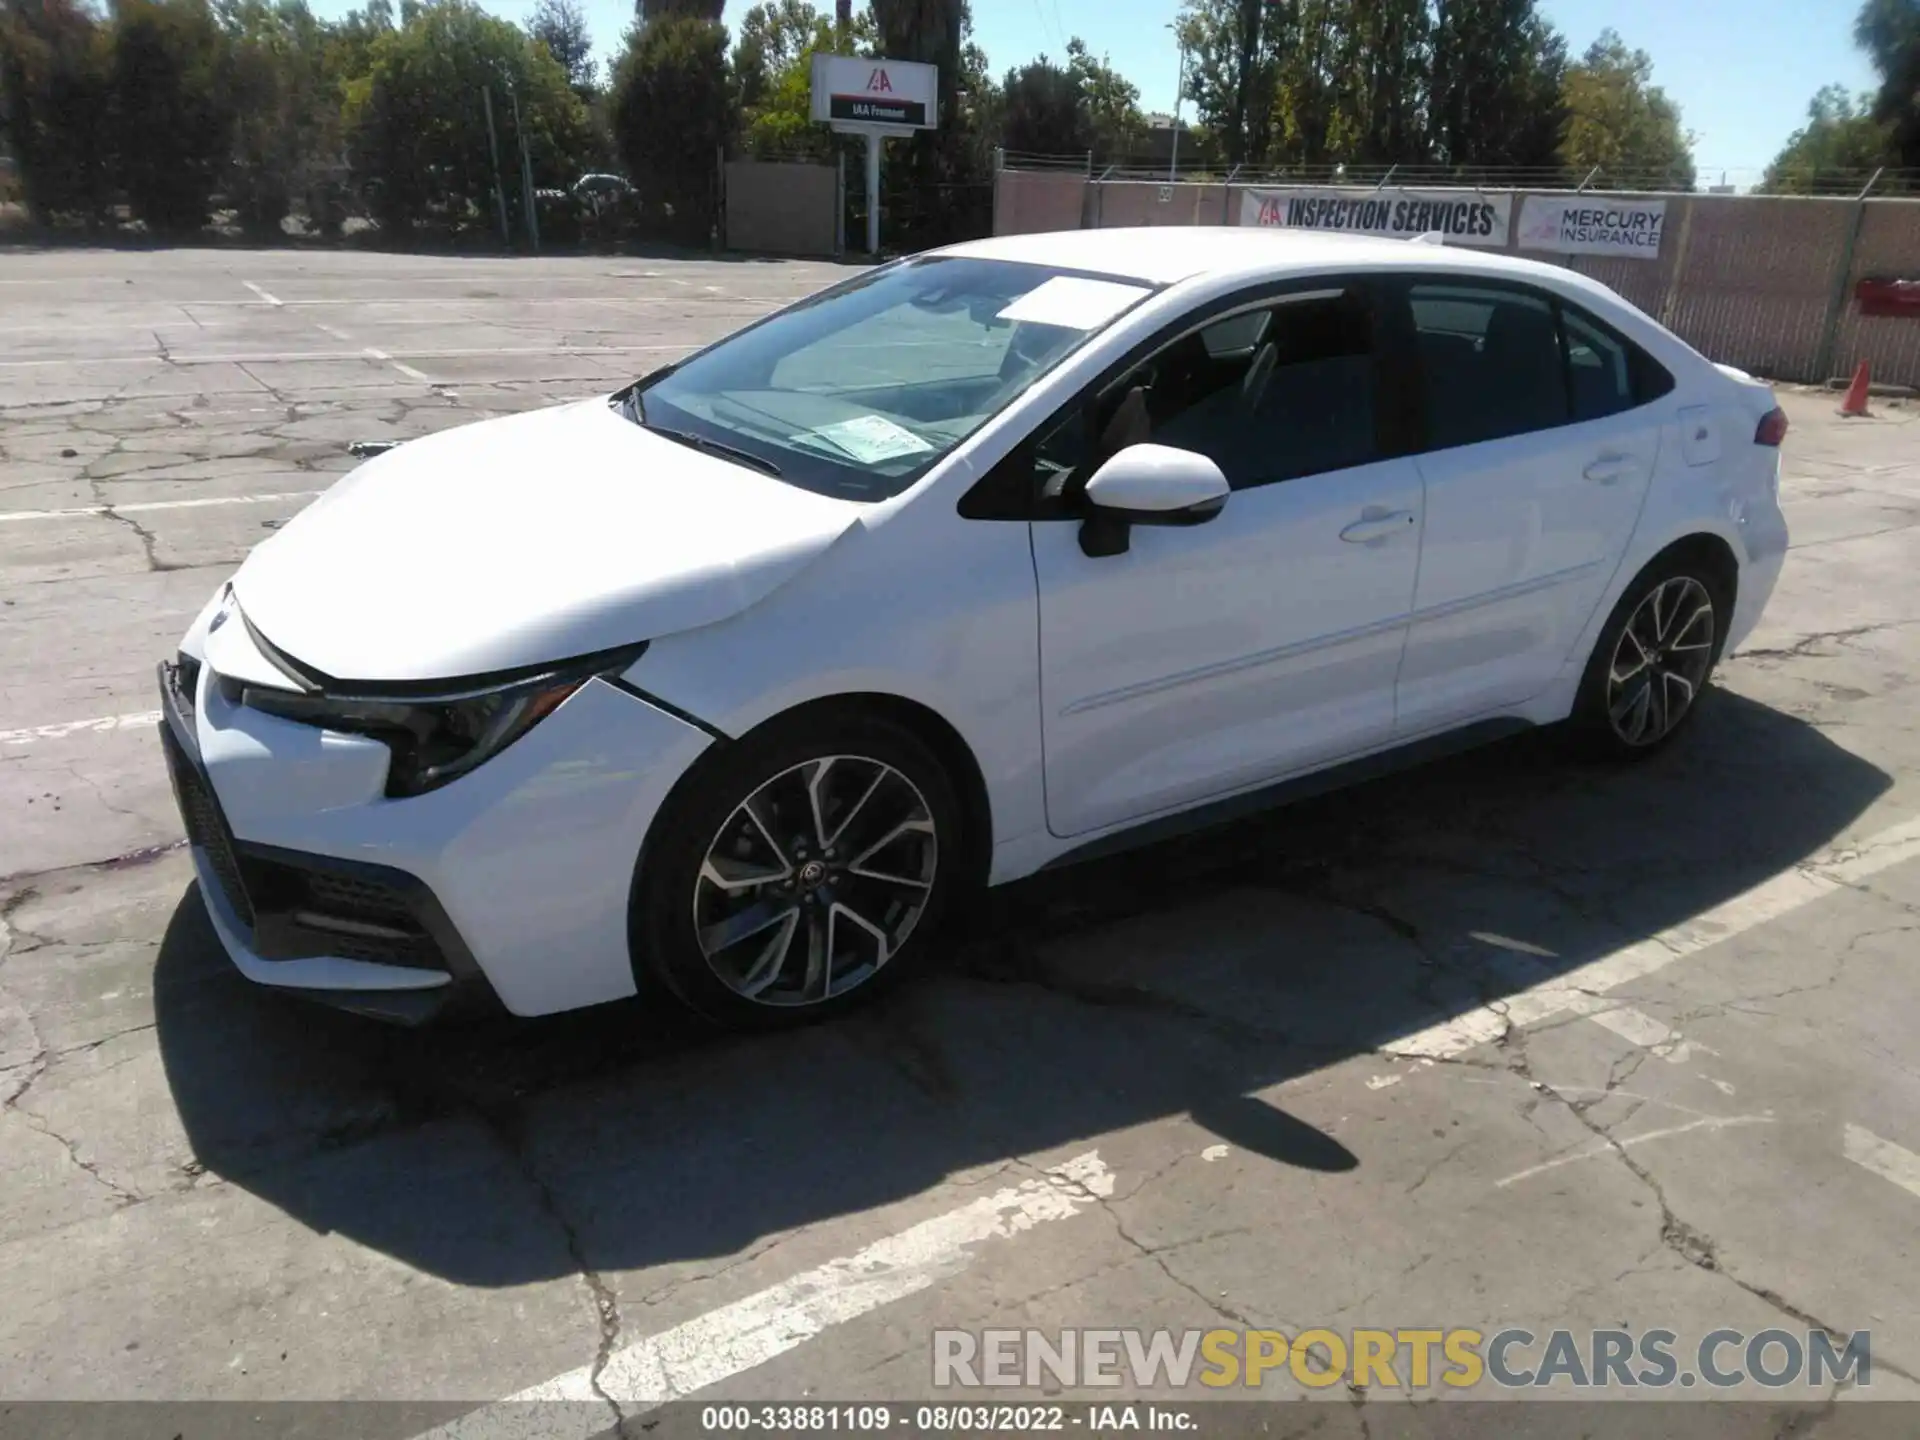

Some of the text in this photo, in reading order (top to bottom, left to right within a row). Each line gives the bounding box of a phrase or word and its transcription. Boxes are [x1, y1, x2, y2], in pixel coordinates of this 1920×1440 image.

[1286, 198, 1392, 231] INSPECTION
[1392, 201, 1495, 236] SERVICES
[1562, 208, 1663, 231] MERCURY
[1560, 227, 1661, 247] INSURANCE
